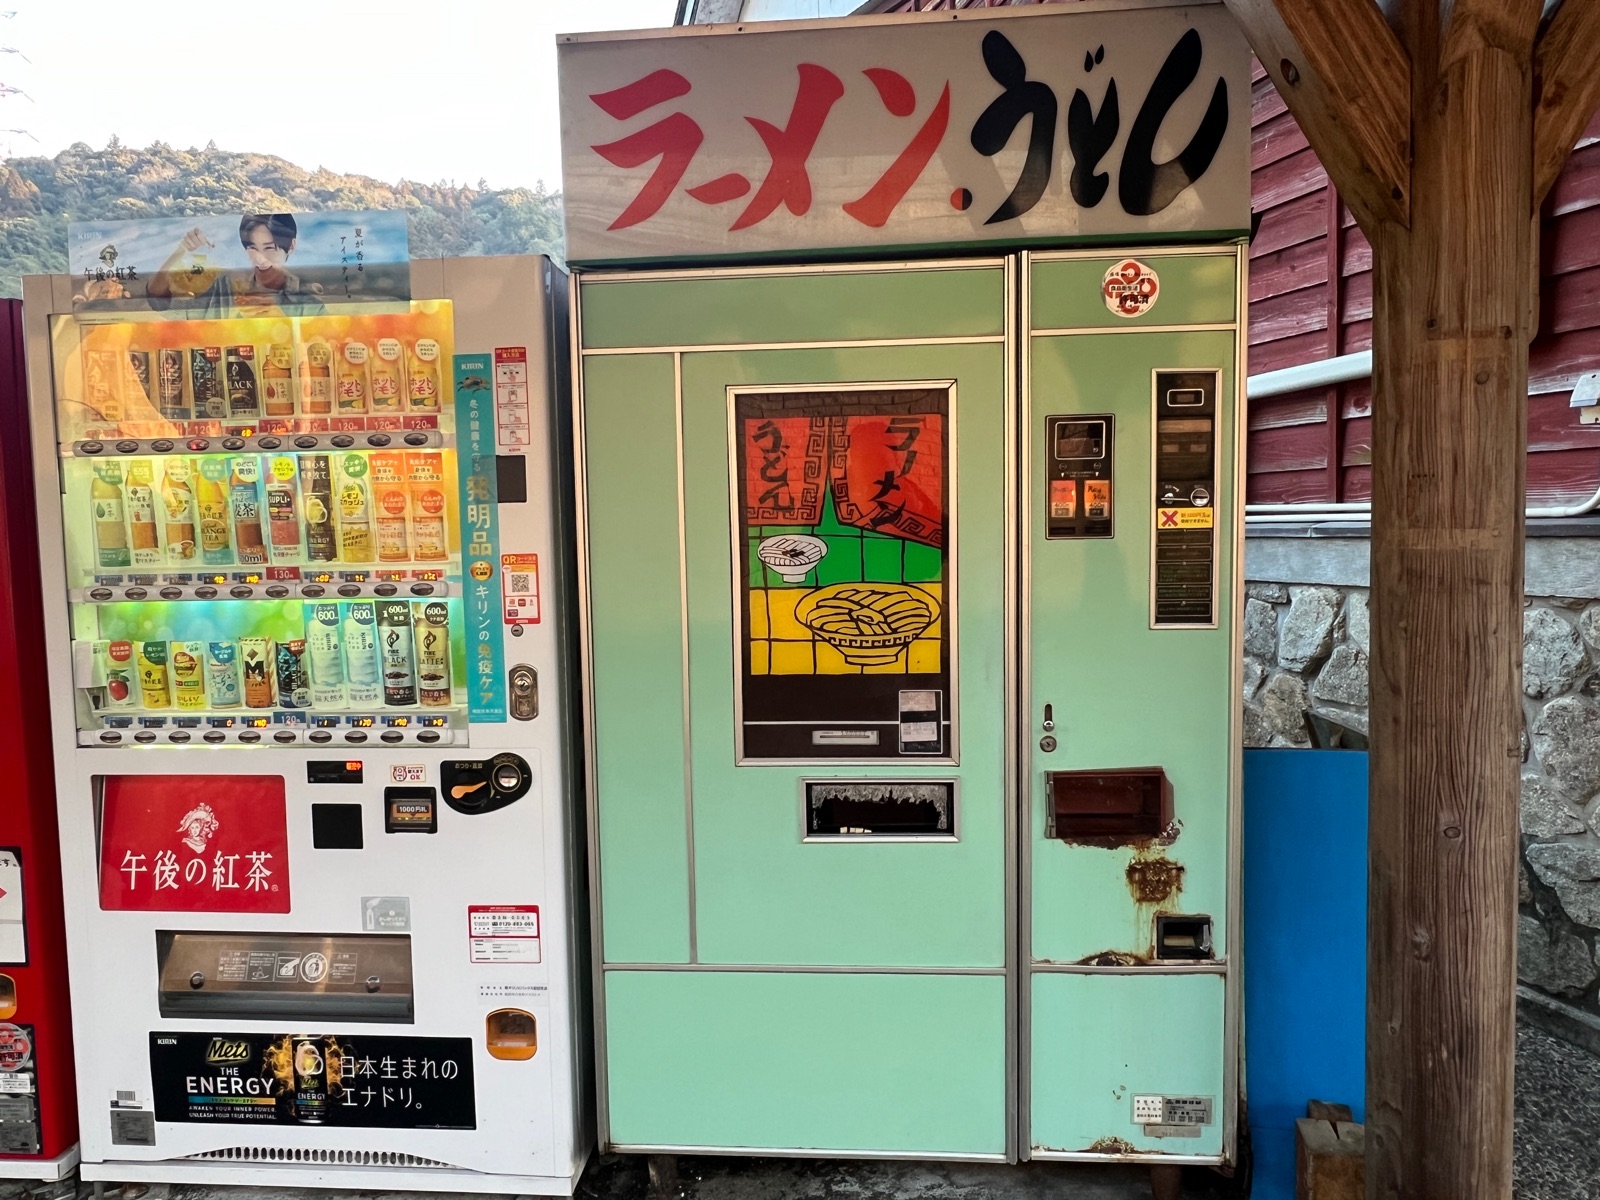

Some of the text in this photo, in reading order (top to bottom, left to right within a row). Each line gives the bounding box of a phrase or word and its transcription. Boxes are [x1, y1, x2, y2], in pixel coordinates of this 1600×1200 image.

[84, 265, 139, 282] 午後の紅茶
[751, 420, 795, 513] うどん
[867, 417, 927, 531] ラーメン
[474, 585, 494, 705] キリンの免疫ケア
[120, 849, 273, 892] 午後の紅茶
[207, 1039, 250, 1059] Mets
[220, 1066, 240, 1076] THE
[340, 1055, 458, 1080] 日本生まれの
[186, 1076, 275, 1095] ENERGY
[341, 1086, 423, 1110] エナドリ。
